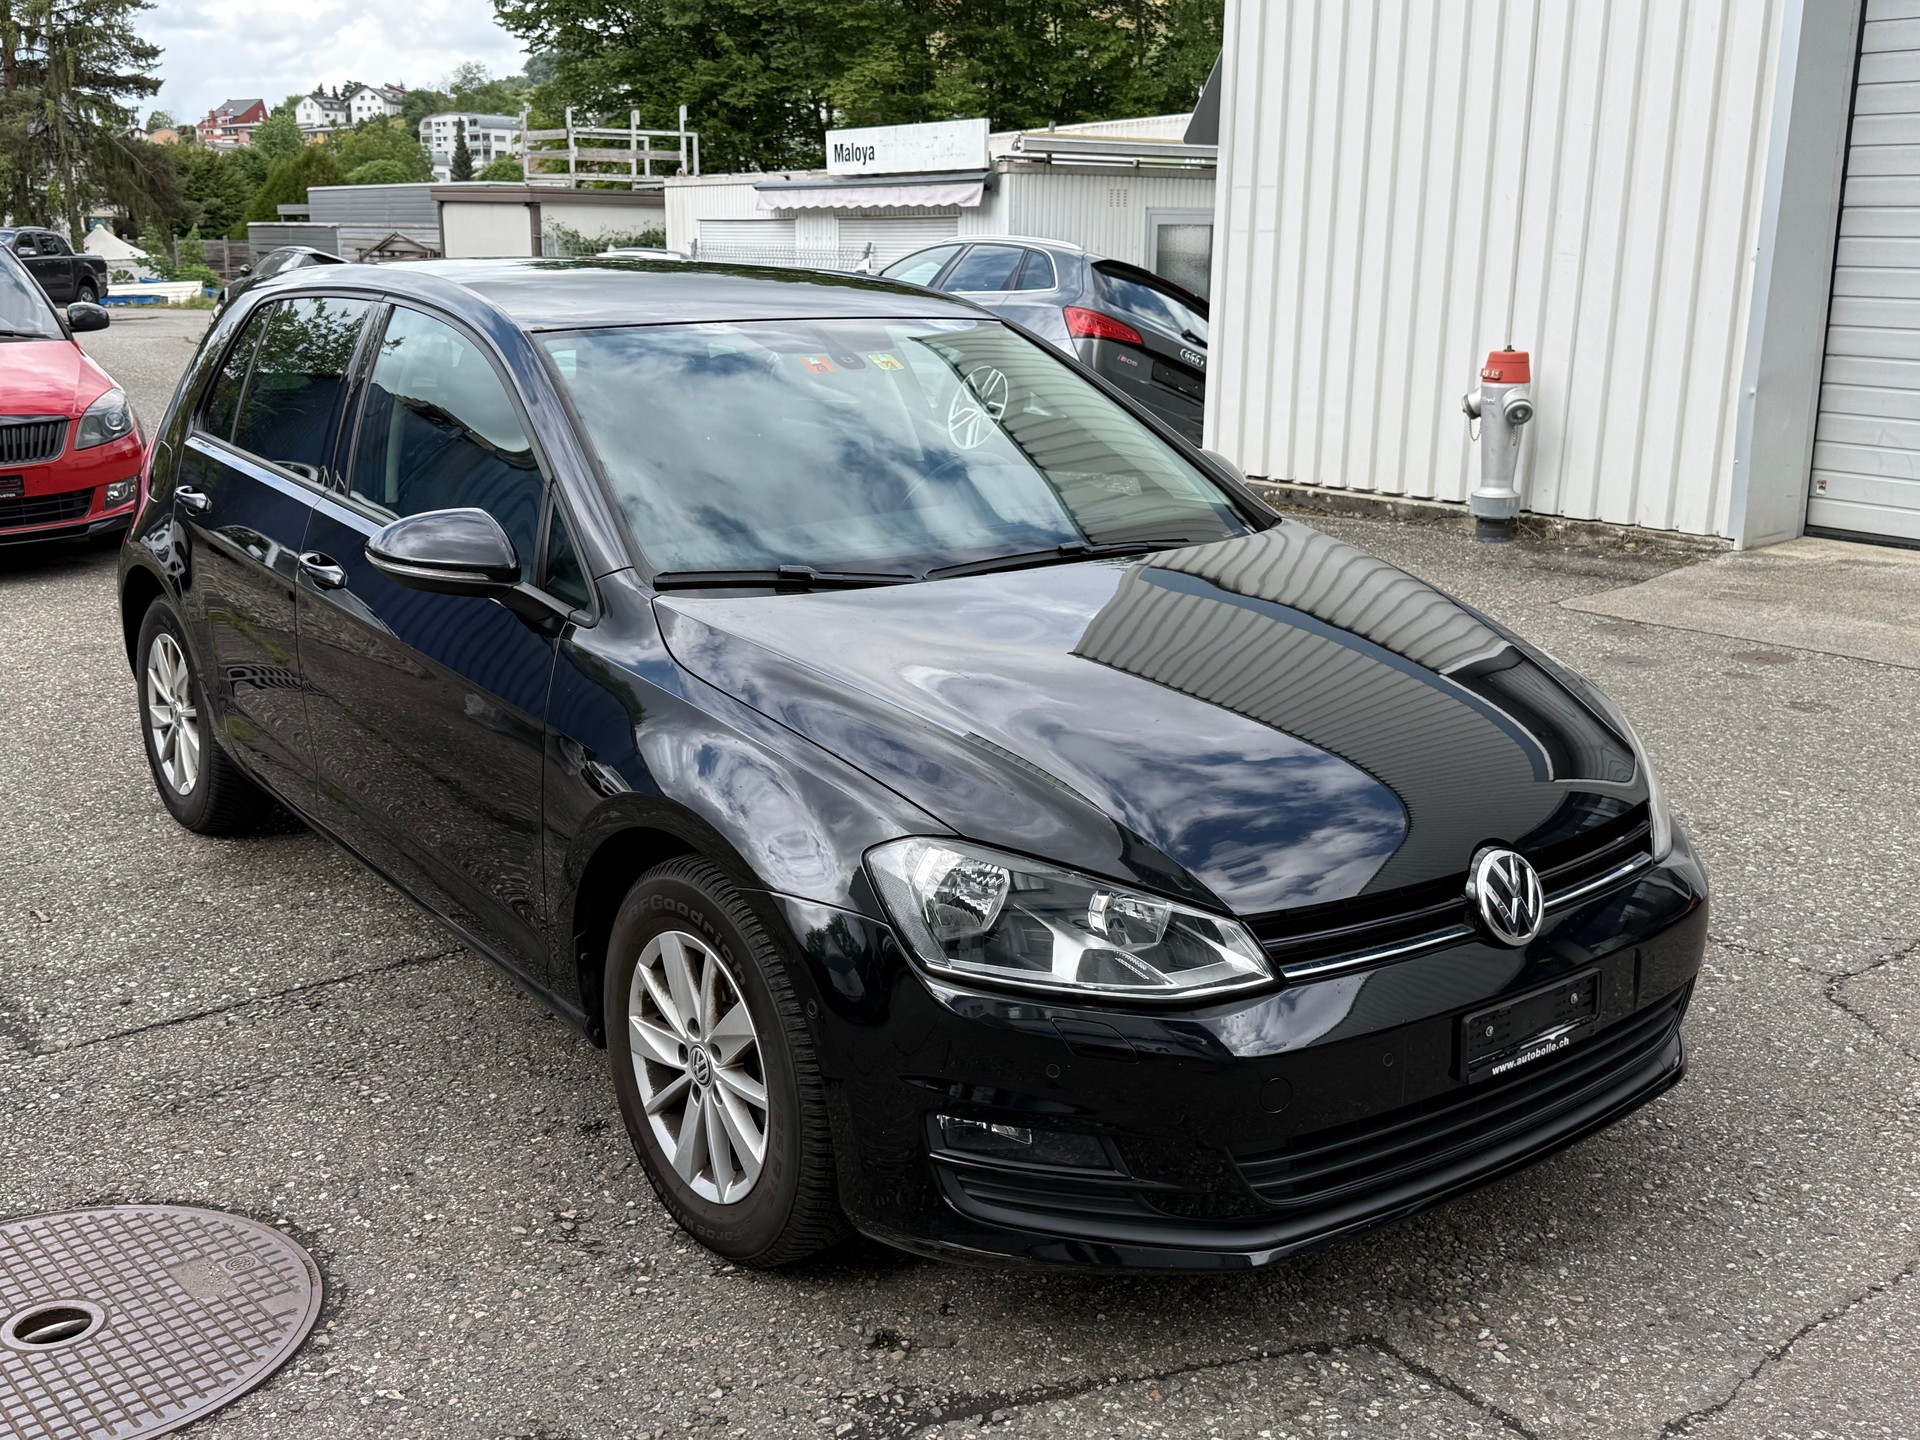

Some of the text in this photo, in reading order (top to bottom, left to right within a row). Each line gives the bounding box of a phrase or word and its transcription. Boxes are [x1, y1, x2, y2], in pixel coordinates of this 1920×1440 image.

[834, 143, 875, 165] Maloya
[628, 894, 747, 987] BFGoodrich
[1492, 1037, 1570, 1075] www.autobolle.ch
